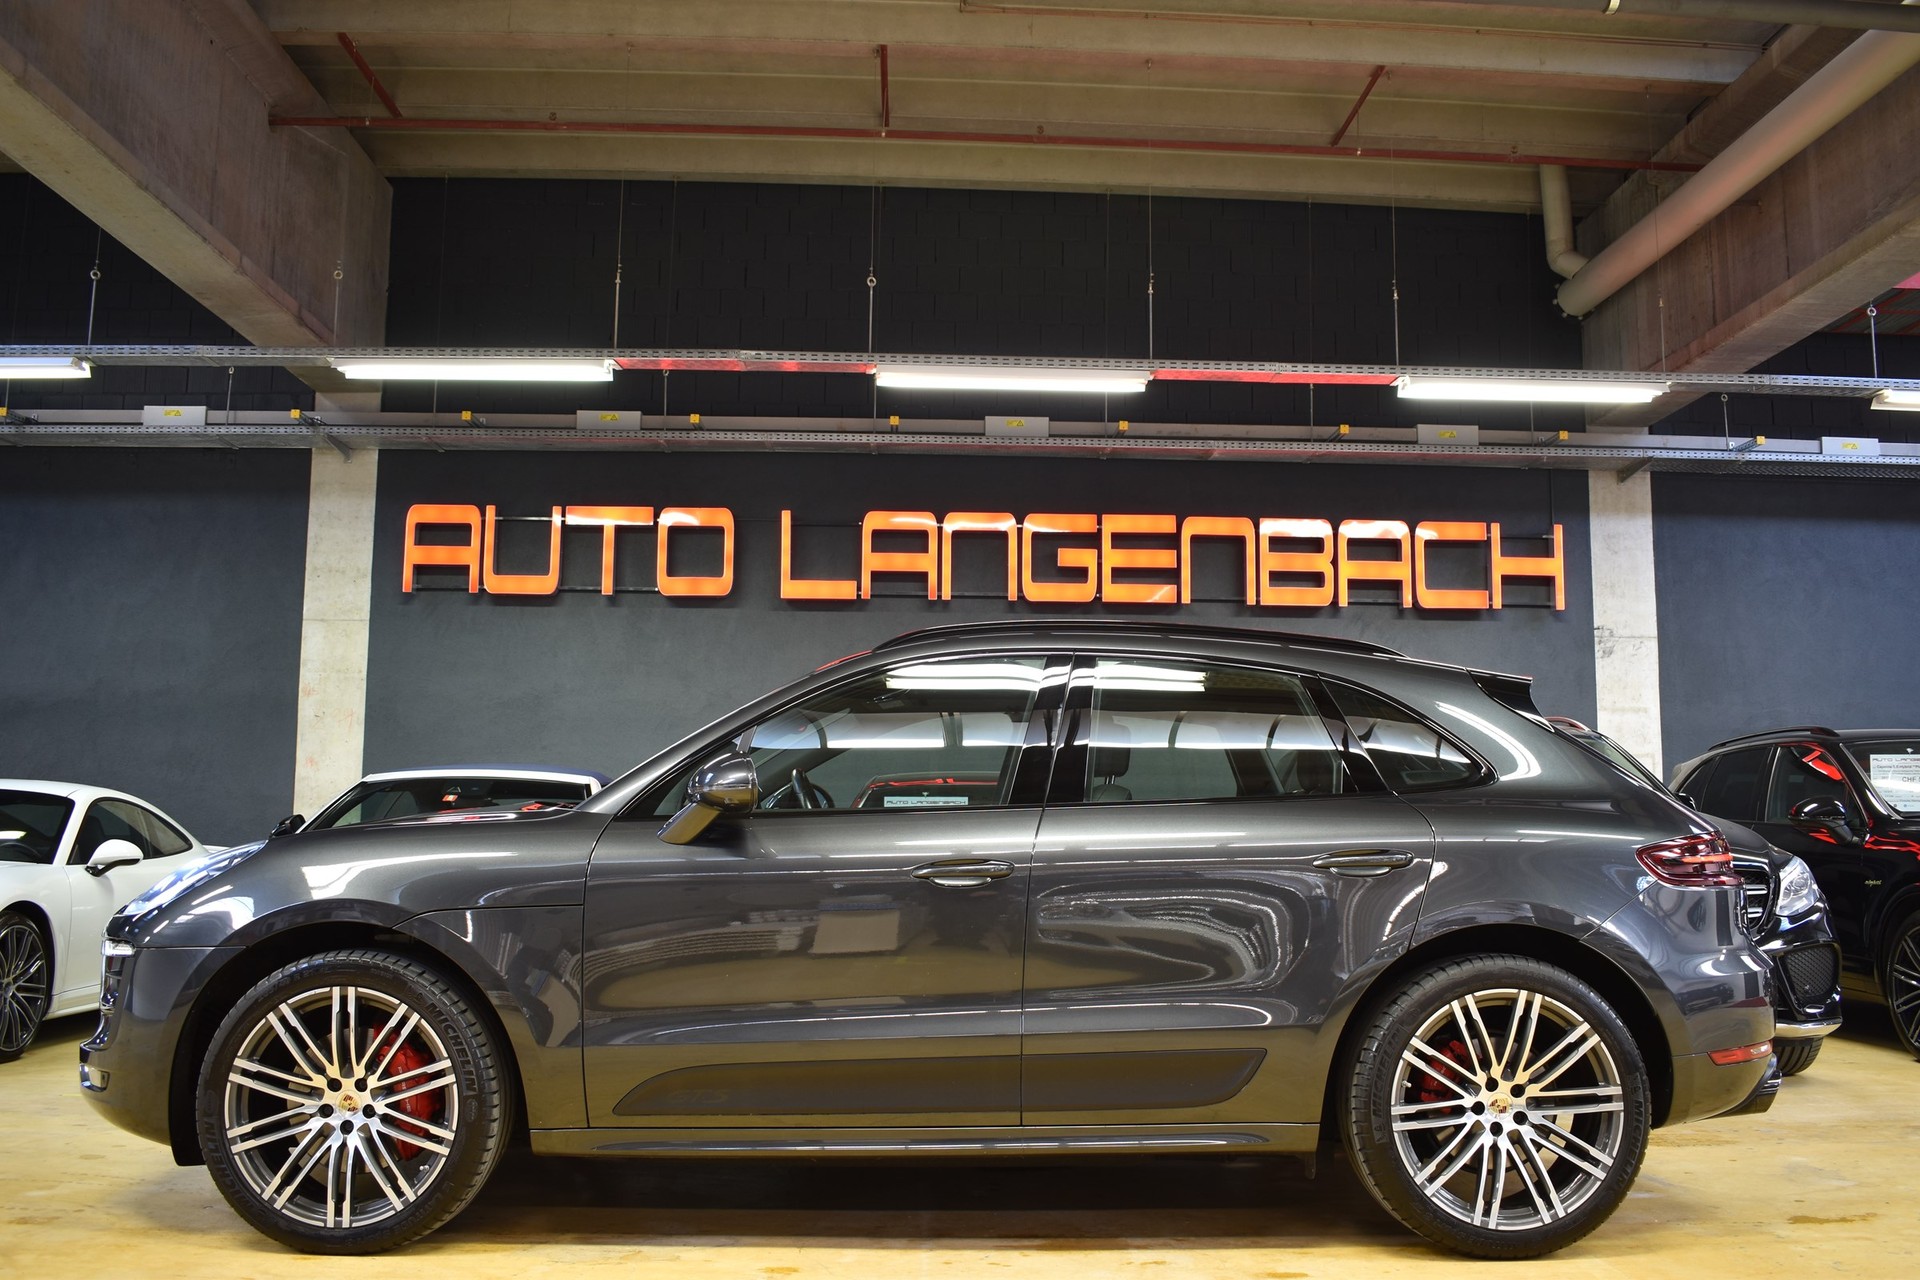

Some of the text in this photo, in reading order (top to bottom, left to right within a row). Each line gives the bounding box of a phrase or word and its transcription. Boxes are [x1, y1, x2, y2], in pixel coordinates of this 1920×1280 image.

[402, 504, 1566, 612] AUTO LANGENBACH
[425, 1002, 479, 1095] MICHELIN
